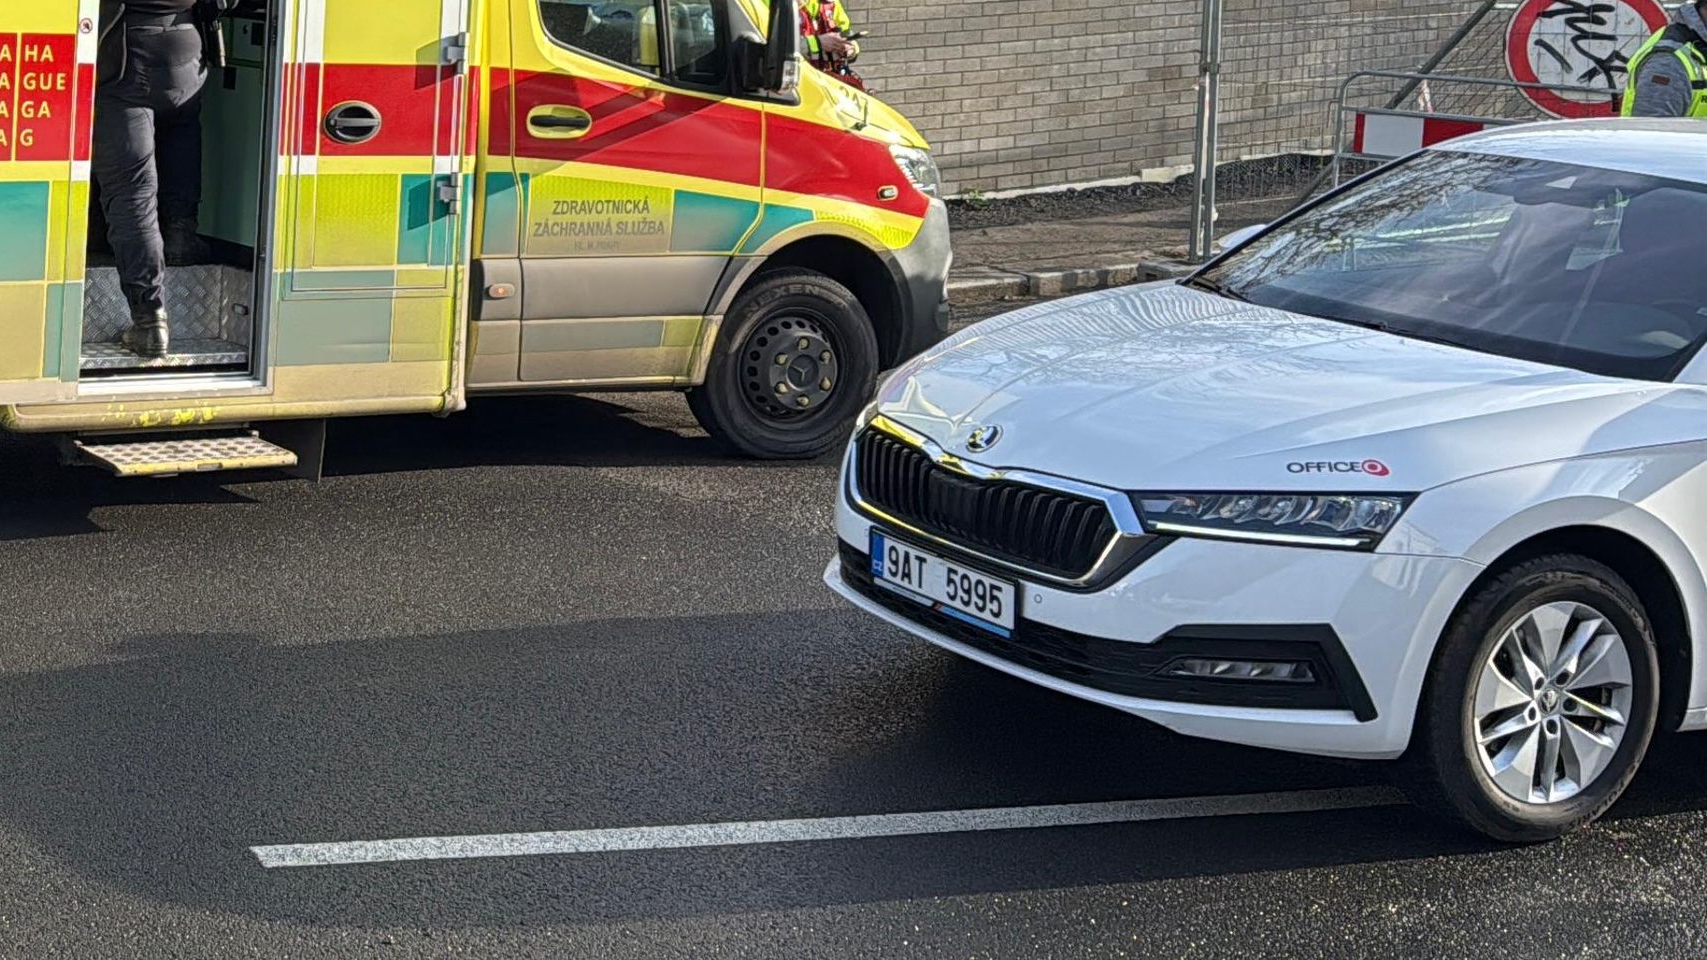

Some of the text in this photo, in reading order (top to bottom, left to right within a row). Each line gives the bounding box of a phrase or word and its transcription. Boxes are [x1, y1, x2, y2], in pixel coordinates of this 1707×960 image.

[552, 196, 650, 215] ZDRAVOTNICKÁ
[533, 217, 665, 237] ZÁCHRANNÁ SLUŽBA
[888, 545, 1003, 619] 9AT 5995
